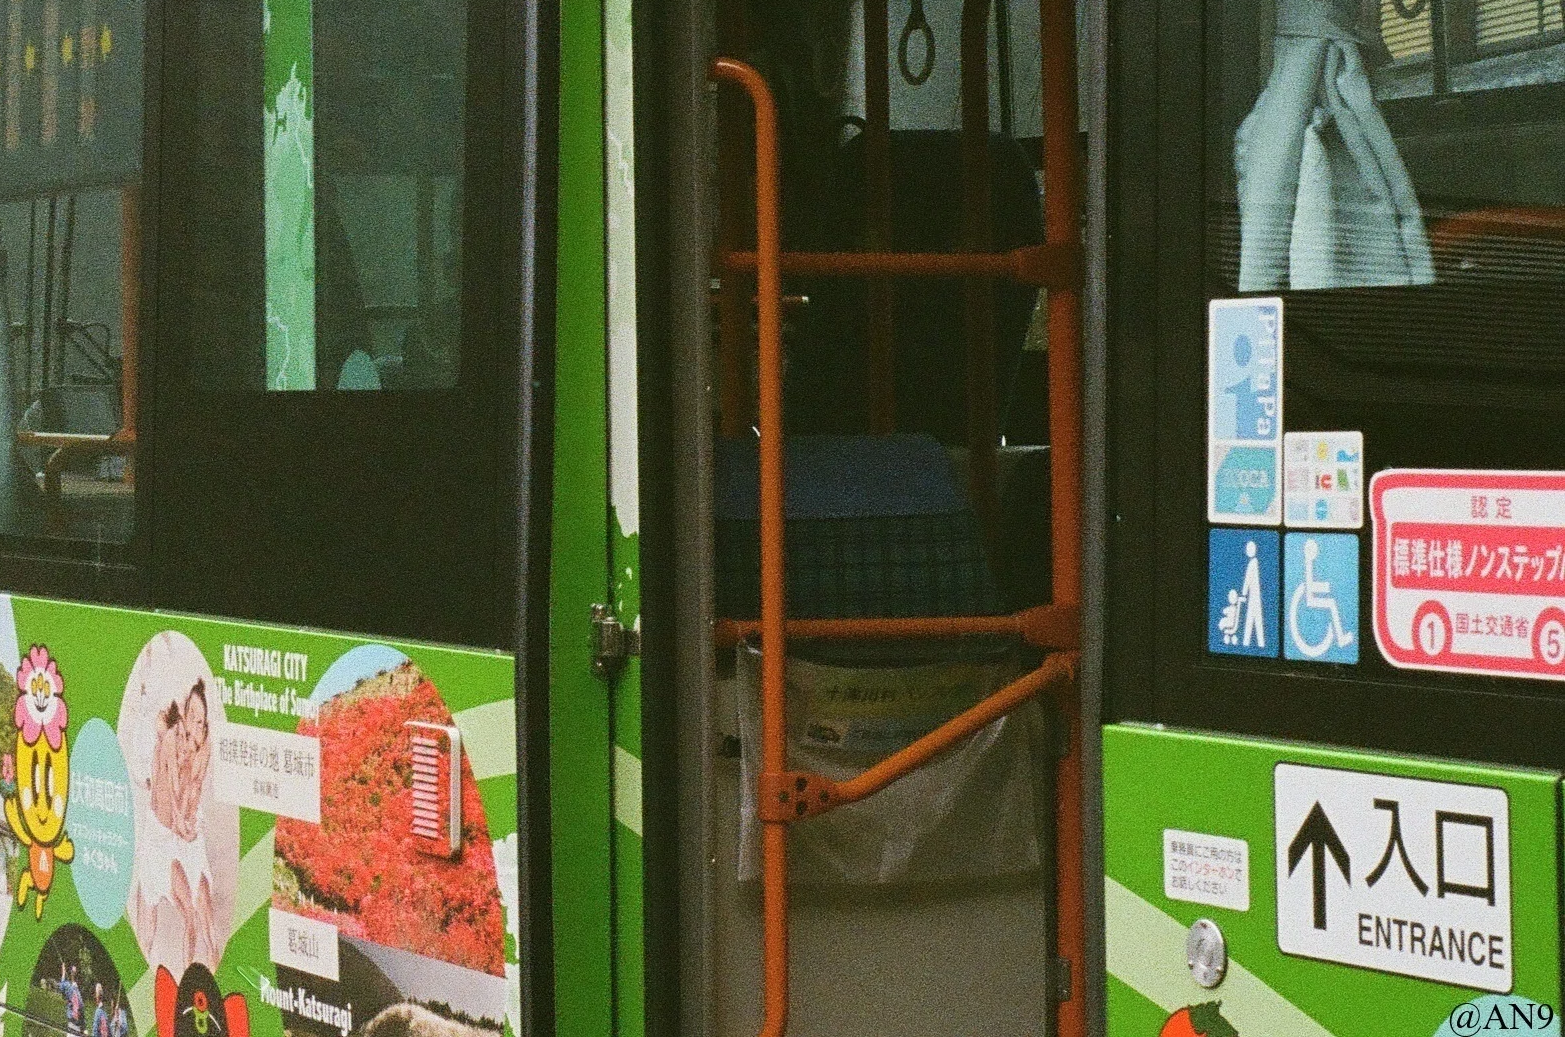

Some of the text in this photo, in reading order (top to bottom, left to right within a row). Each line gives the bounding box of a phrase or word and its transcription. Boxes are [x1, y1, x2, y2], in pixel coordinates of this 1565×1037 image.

[1470, 495, 1513, 521] 認定
[1393, 537, 1565, 582] 標準仕様ノンステップ
[1455, 612, 1533, 641] 国土交通省
[223, 644, 308, 682] KATSURAGI CITY
[215, 676, 233, 705] The
[234, 679, 278, 718] Birthplace
[279, 687, 290, 714] of
[282, 747, 315, 778] 葛城市
[1366, 797, 1496, 907] 入口
[1357, 912, 1505, 969] ENTRANCE
